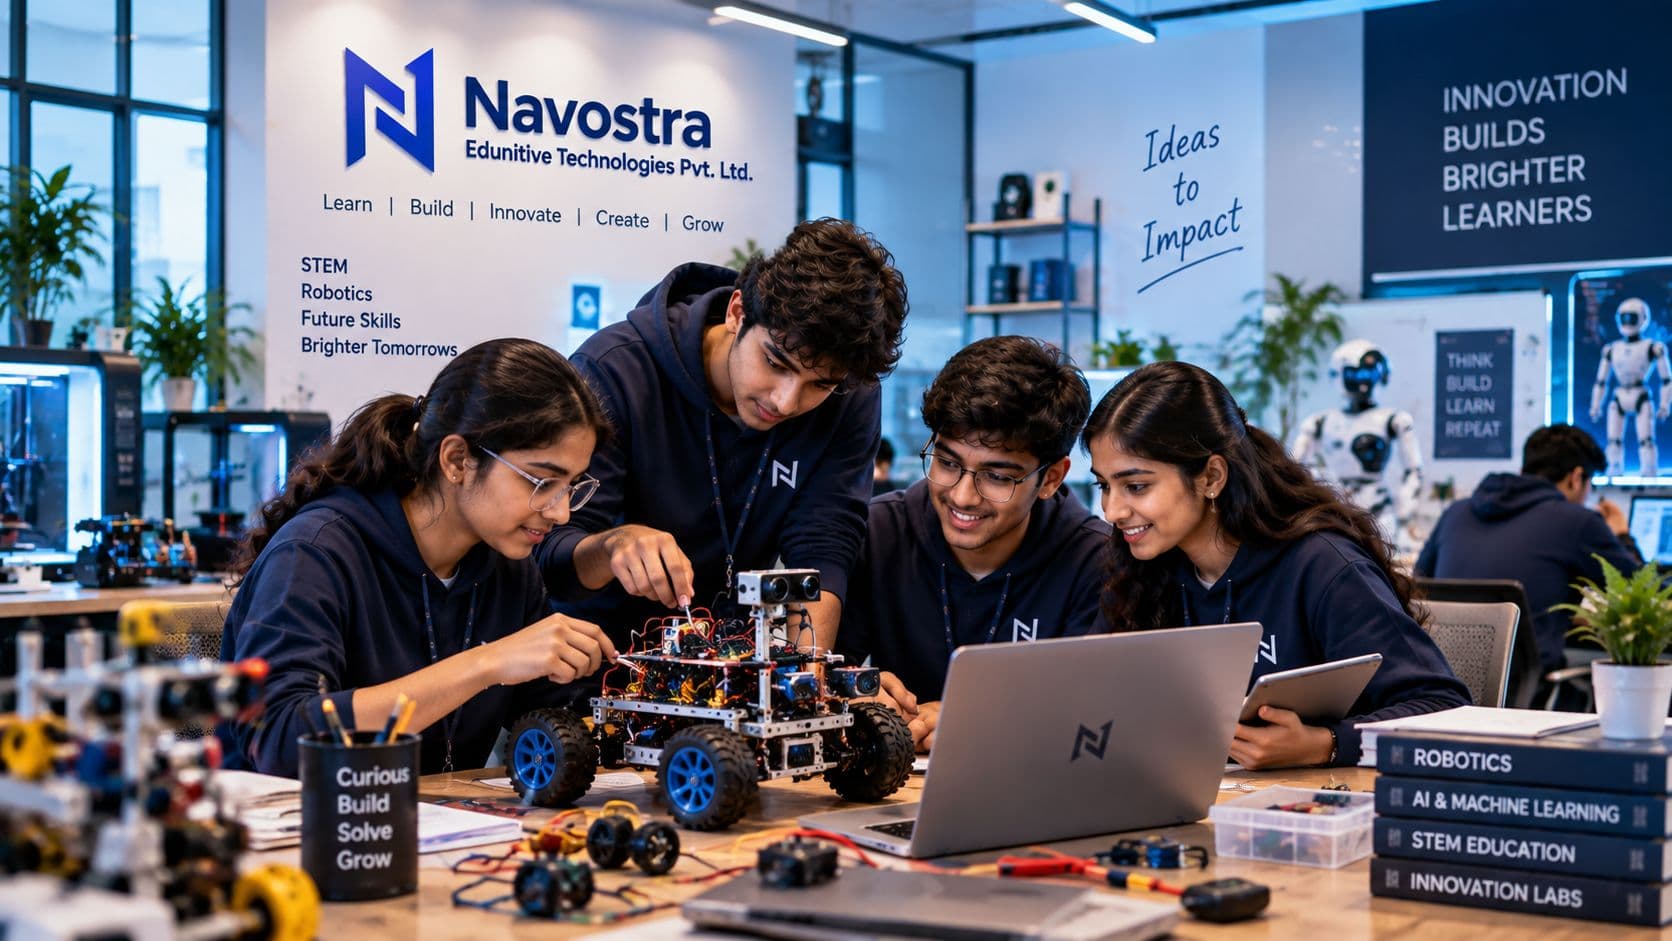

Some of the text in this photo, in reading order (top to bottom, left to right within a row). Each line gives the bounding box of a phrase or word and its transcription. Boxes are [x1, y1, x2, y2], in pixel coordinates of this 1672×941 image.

[1443, 67, 1627, 113] INNOVATION
[465, 76, 711, 148] Navostra
[1143, 124, 1220, 172] Ideas
[1443, 117, 1545, 152] BUILDS
[465, 139, 753, 181] Edunitive Technologies Pvt. Ltd.
[1443, 154, 1586, 192] BRIGHTER
[1173, 172, 1199, 206] to
[323, 193, 724, 233] Learn Build Innovate Create Grow
[1443, 195, 1592, 231] LEARNERS
[1141, 197, 1243, 262] Impact
[301, 256, 348, 274] STEM
[301, 283, 373, 301] Robotics
[301, 310, 401, 329] Future Skills
[301, 337, 458, 357] Brighter Tomorrows
[1446, 352, 1494, 369] THINK
[1446, 375, 1492, 392] BUILD
[1446, 397, 1495, 414] LEARN
[1445, 421, 1501, 438] REPEAT
[1414, 748, 1512, 773] ROBOTICS
[336, 766, 410, 788] Curious
[337, 793, 390, 815] Build
[1412, 790, 1620, 824] AI & MACHINE LEARNING
[337, 822, 394, 843] Solve
[336, 850, 393, 870] Grow
[1412, 831, 1576, 864] STEM EDUCATION
[1410, 873, 1583, 909] INNOVATION LABS
